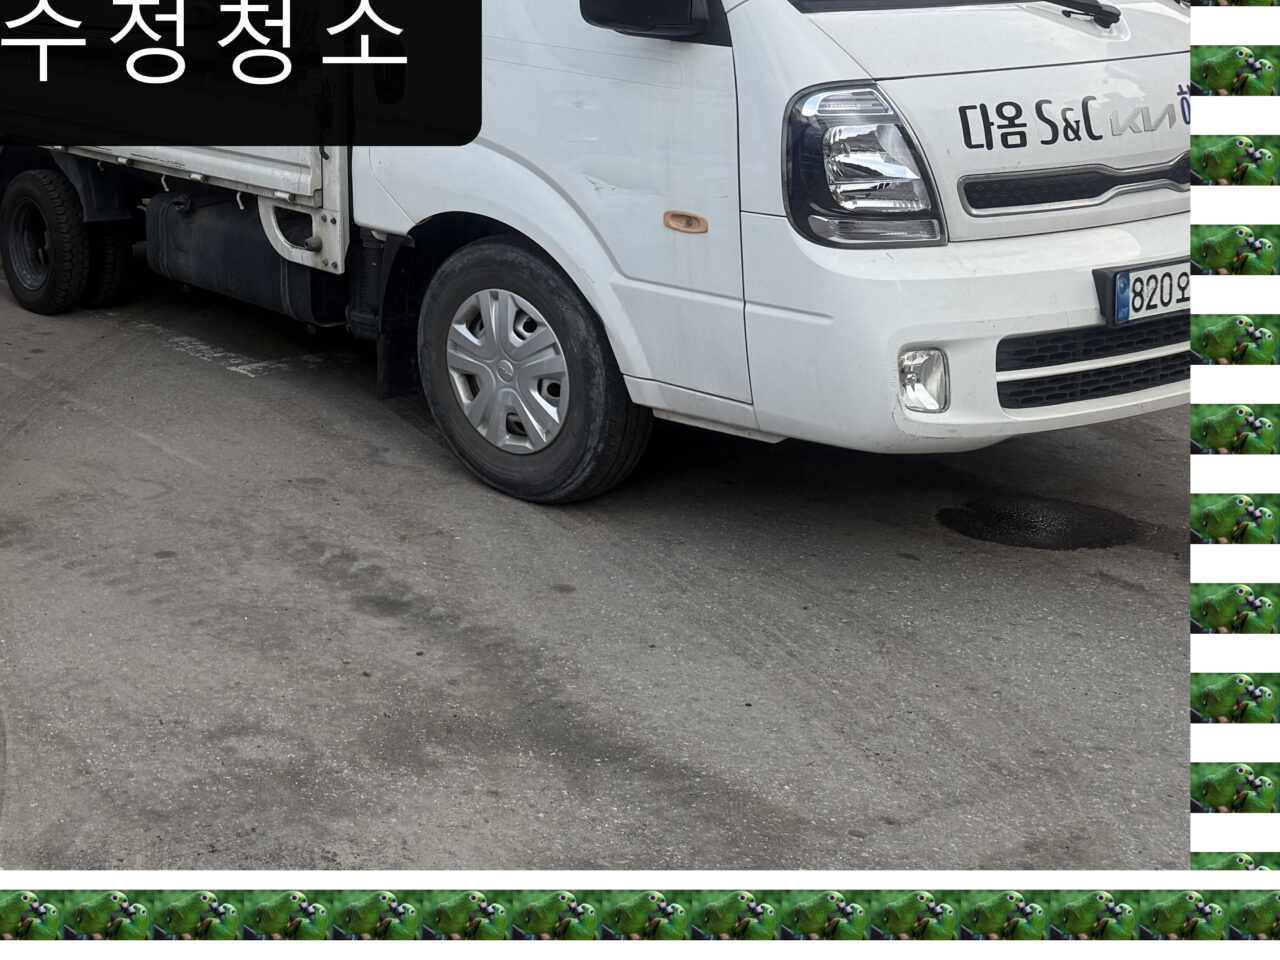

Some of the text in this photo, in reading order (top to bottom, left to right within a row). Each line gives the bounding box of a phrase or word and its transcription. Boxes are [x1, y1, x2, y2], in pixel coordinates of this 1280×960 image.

[958, 96, 1104, 151] 다옴 S&C
[1131, 271, 1190, 313] 820오
